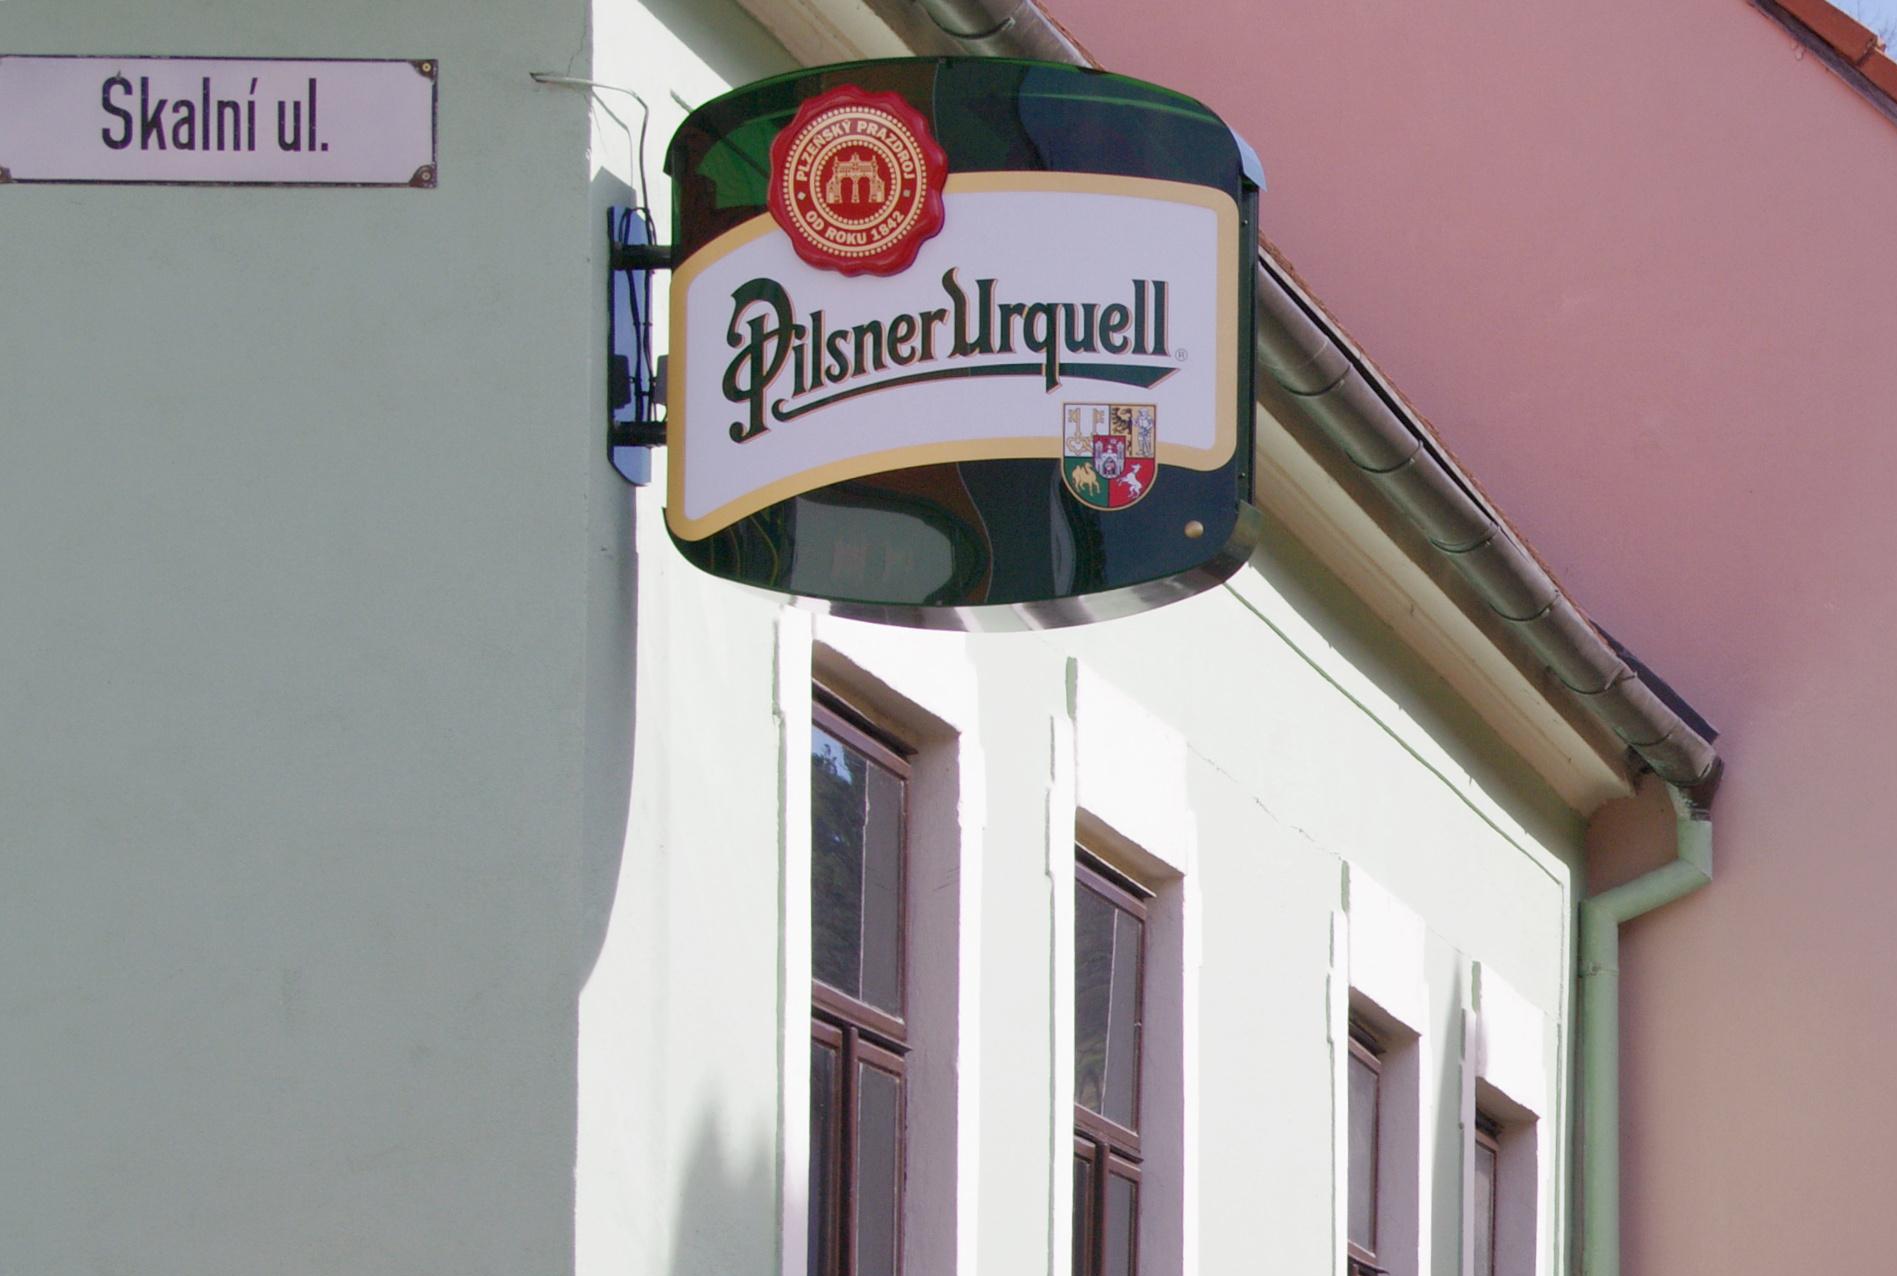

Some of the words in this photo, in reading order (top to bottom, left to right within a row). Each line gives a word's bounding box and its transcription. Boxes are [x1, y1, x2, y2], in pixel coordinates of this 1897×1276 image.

[101, 75, 258, 151] Skalní
[277, 77, 329, 152] ul.
[856, 120, 916, 180] PRAZDROJ
[805, 210, 825, 231] OD
[824, 227, 867, 245] ROKU
[871, 210, 904, 241] 1842
[722, 277, 949, 444] Pilsner
[941, 266, 1171, 394] Urquell
